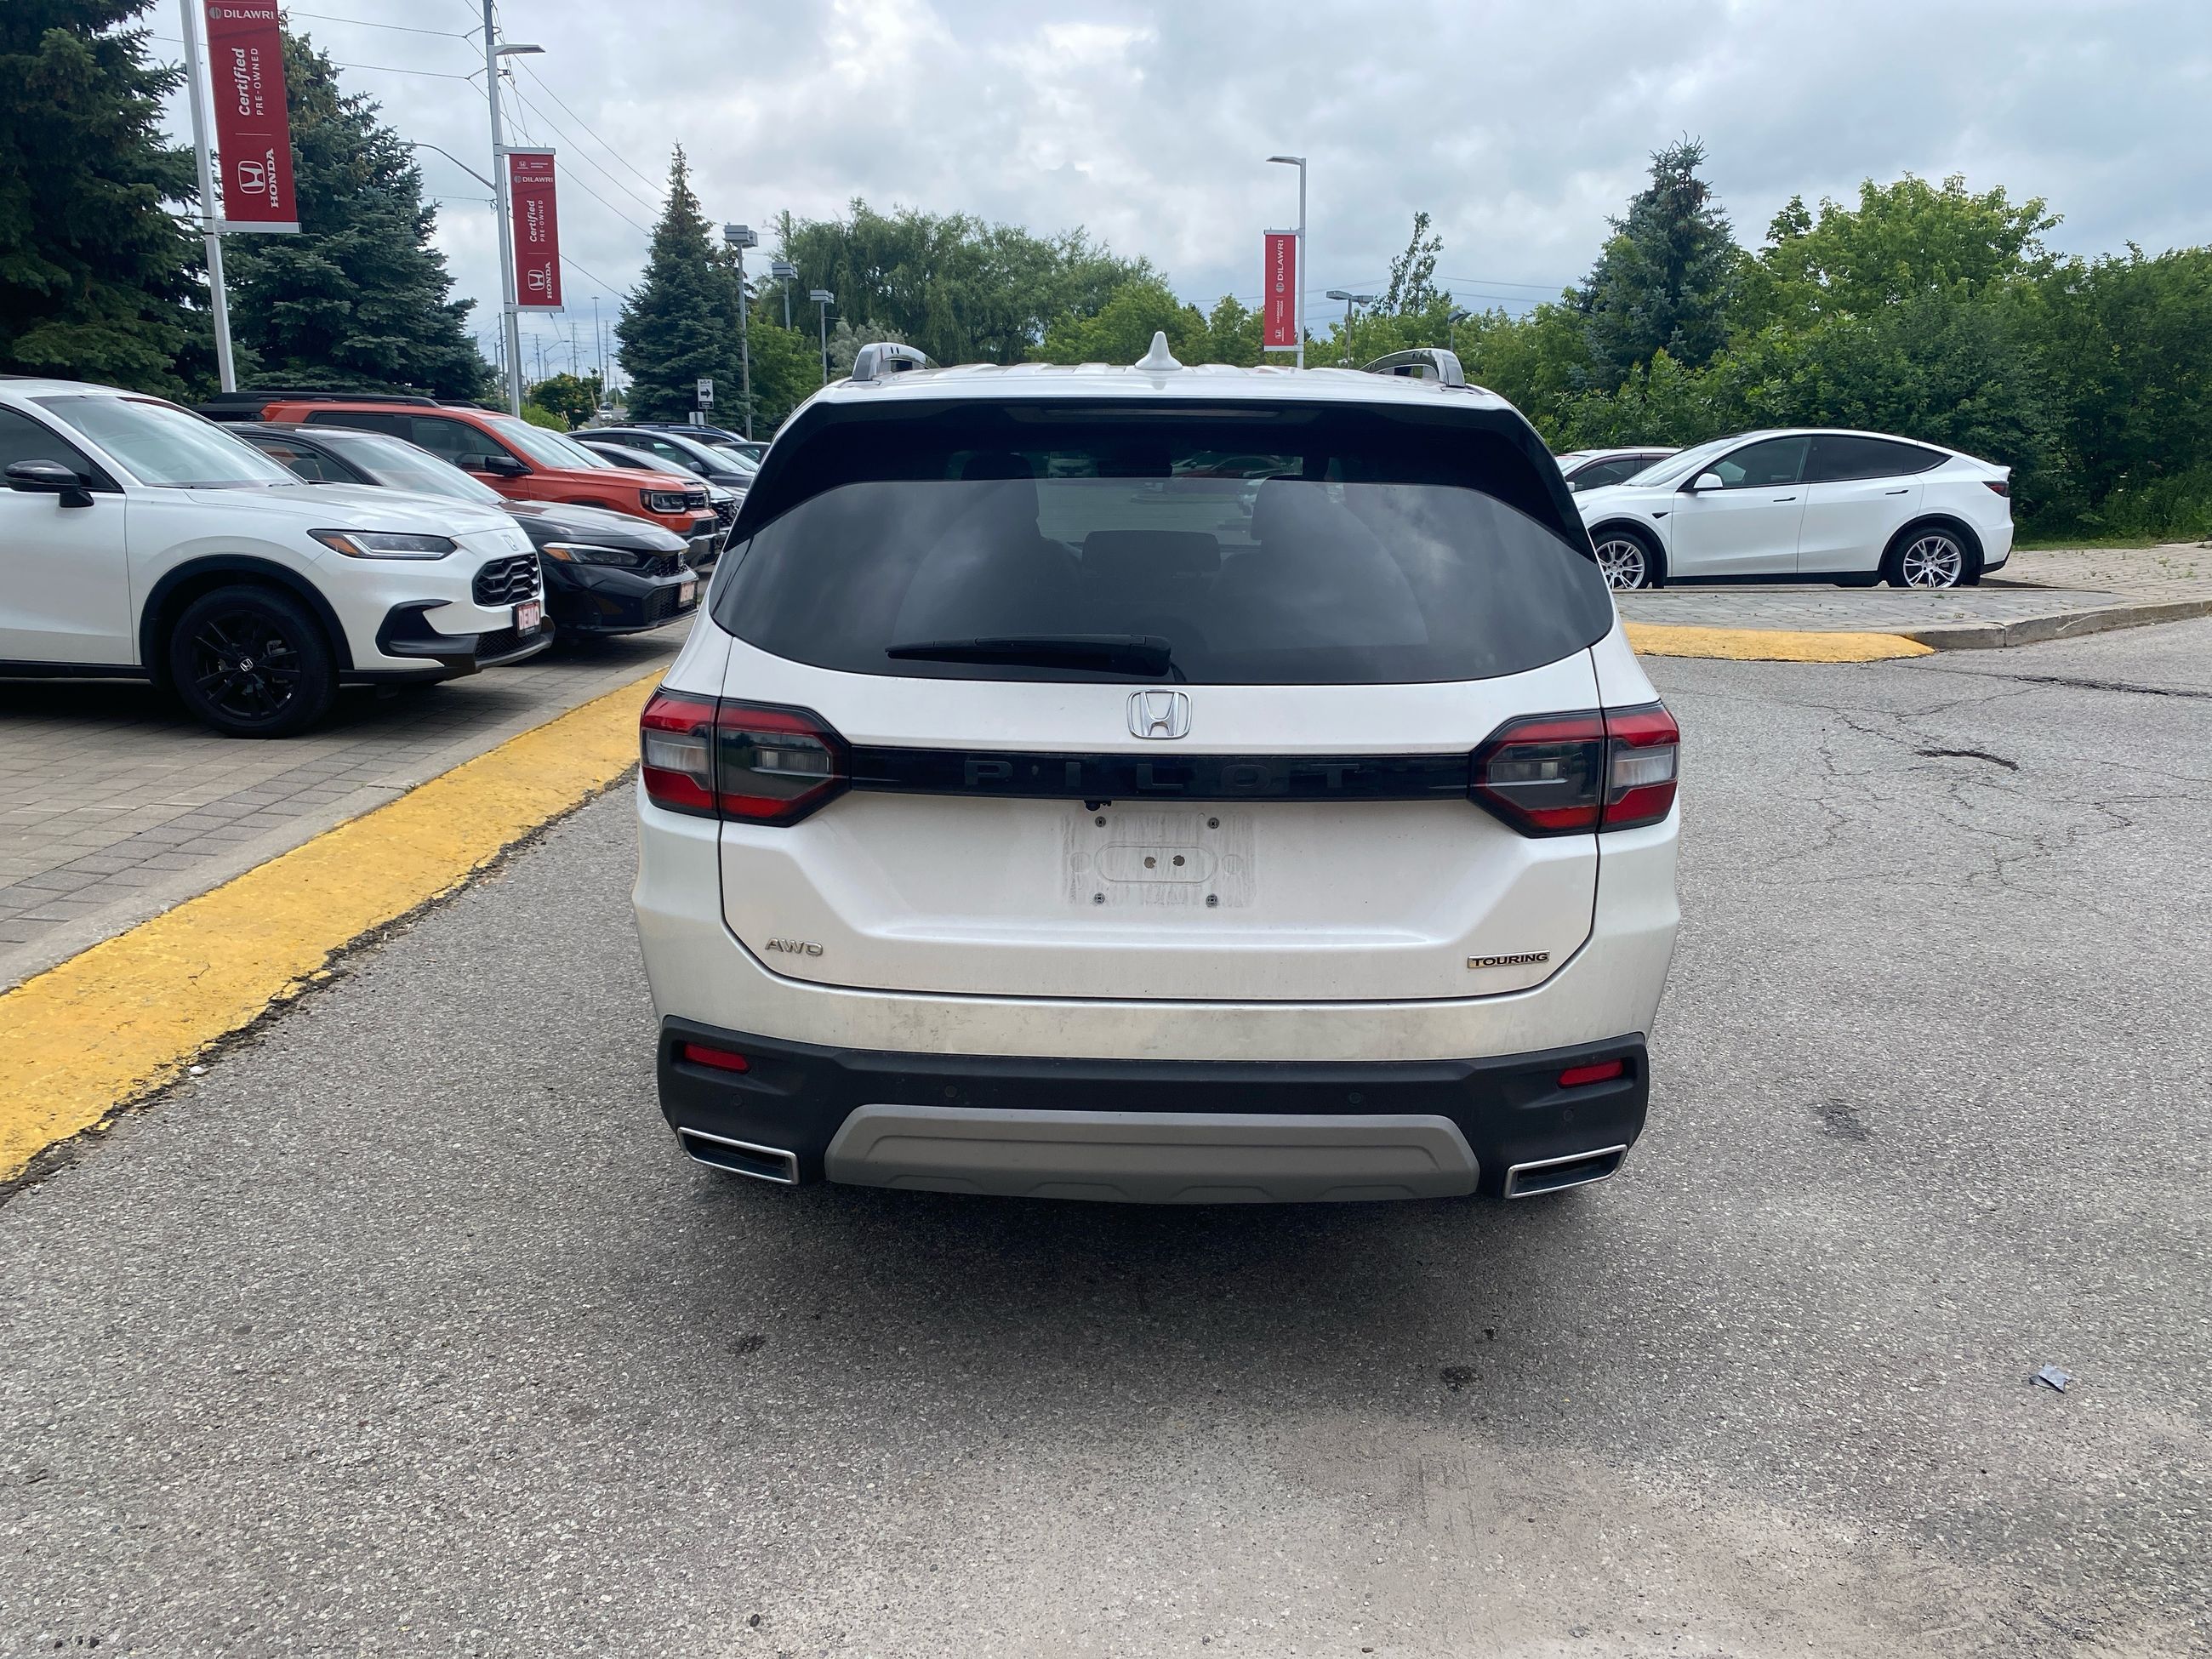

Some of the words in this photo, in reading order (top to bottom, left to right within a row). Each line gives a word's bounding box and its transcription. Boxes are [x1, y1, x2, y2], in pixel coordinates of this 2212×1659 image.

[223, 9, 275, 20] DILAWRI
[231, 48, 251, 117] Certified
[250, 48, 265, 116] PRE-OWNED
[265, 148, 279, 208] HONDA
[526, 200, 538, 242] Certified
[518, 604, 540, 630] DEMO
[963, 759, 1361, 791] PILOT
[765, 938, 824, 957] AWD
[1472, 953, 1548, 966] TOURING
